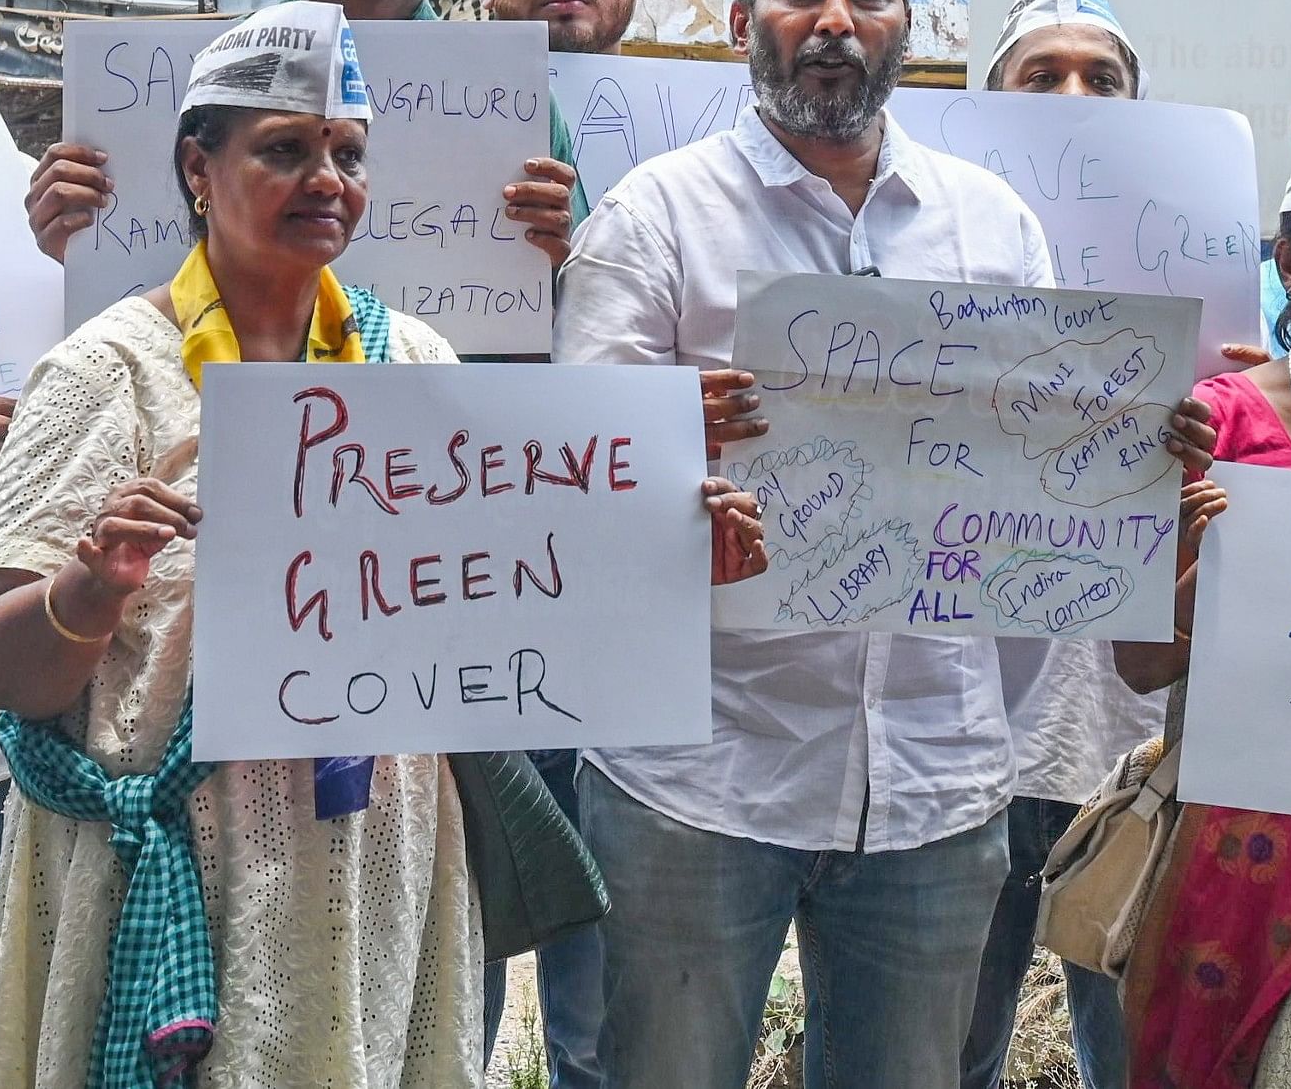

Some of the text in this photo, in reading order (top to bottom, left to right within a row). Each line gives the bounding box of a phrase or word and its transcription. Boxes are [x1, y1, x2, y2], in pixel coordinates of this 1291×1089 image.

[255, 26, 319, 51] PARTY
[929, 290, 1047, 330] Badminton
[761, 309, 979, 396] SPACE
[1072, 347, 1149, 425] FOREST
[1010, 360, 1076, 425] MINI
[292, 385, 639, 518] PRESERVE
[906, 417, 984, 478] FOR
[1054, 416, 1139, 491] SKATING
[778, 471, 846, 544] GROUND
[933, 502, 1175, 567] COMMUNITY
[284, 532, 564, 641] GREEN
[925, 549, 982, 583] FOR
[908, 589, 975, 624] ALL
[277, 648, 583, 726] COVER
